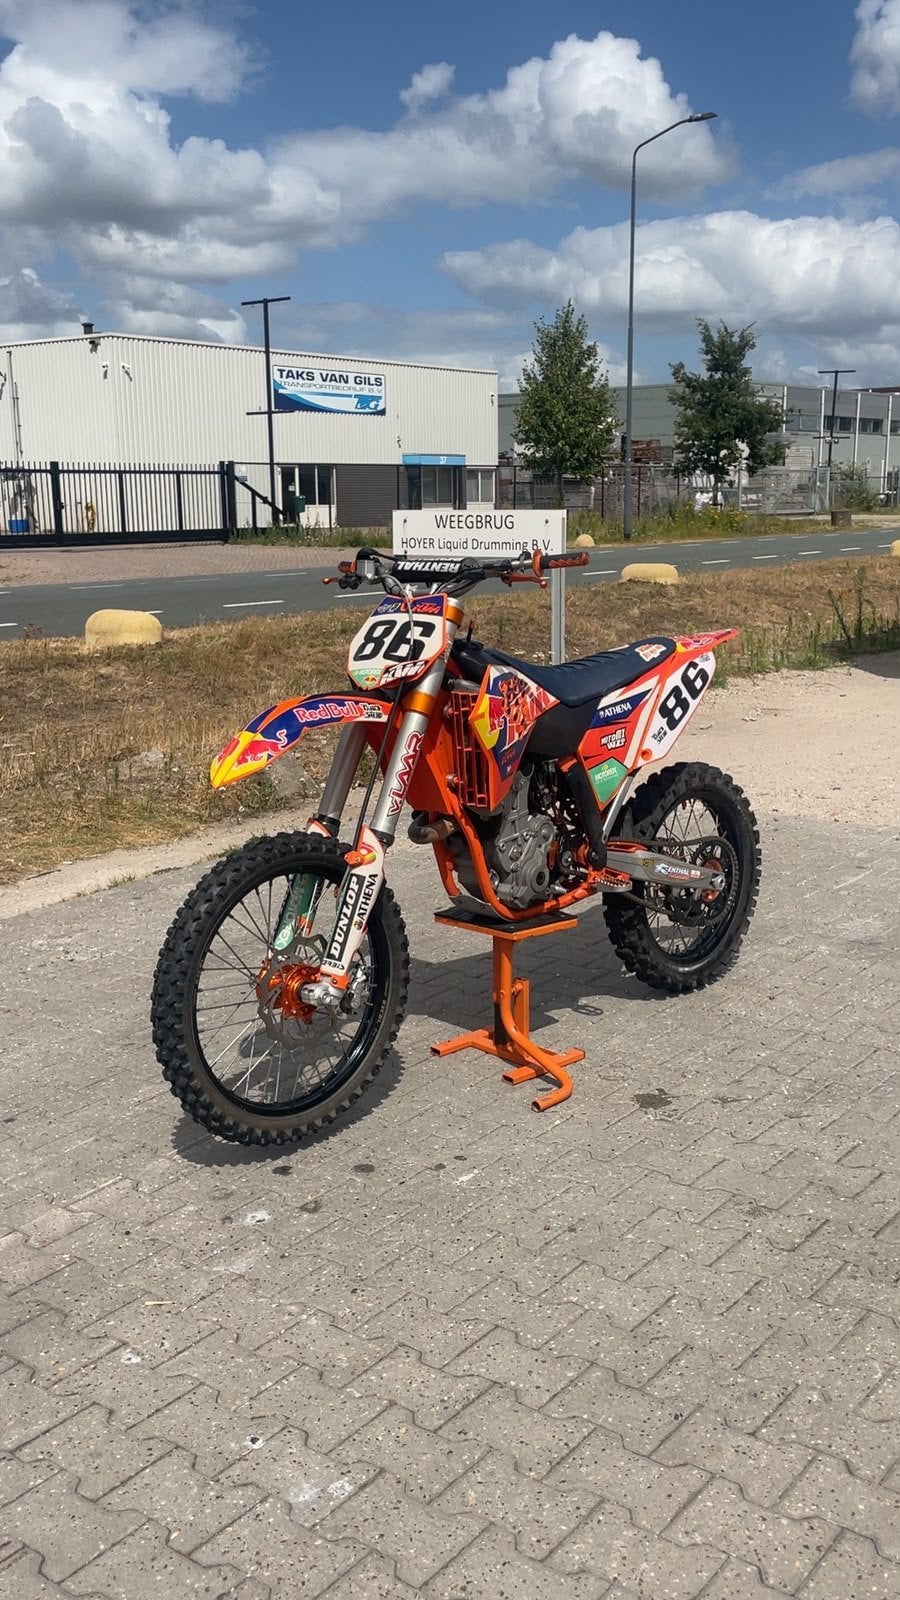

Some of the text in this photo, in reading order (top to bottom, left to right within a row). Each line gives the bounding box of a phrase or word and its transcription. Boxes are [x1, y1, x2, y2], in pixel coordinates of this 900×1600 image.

[277, 368, 383, 387] TAKS VAN GILS
[440, 456, 447, 464] 37
[435, 514, 515, 530] WEEGBRUG
[401, 537, 435, 549] HOYER
[438, 538, 468, 552] Liquid
[471, 539, 529, 552] Drumming
[397, 561, 461, 573] RENTHAL
[353, 619, 437, 662] 86
[658, 661, 710, 731] 86
[293, 703, 331, 723] Red
[325, 701, 360, 718] Bull
[604, 702, 632, 717] ATHENA
[357, 873, 379, 922] ATHENA
[330, 875, 361, 960] DUNLOP
